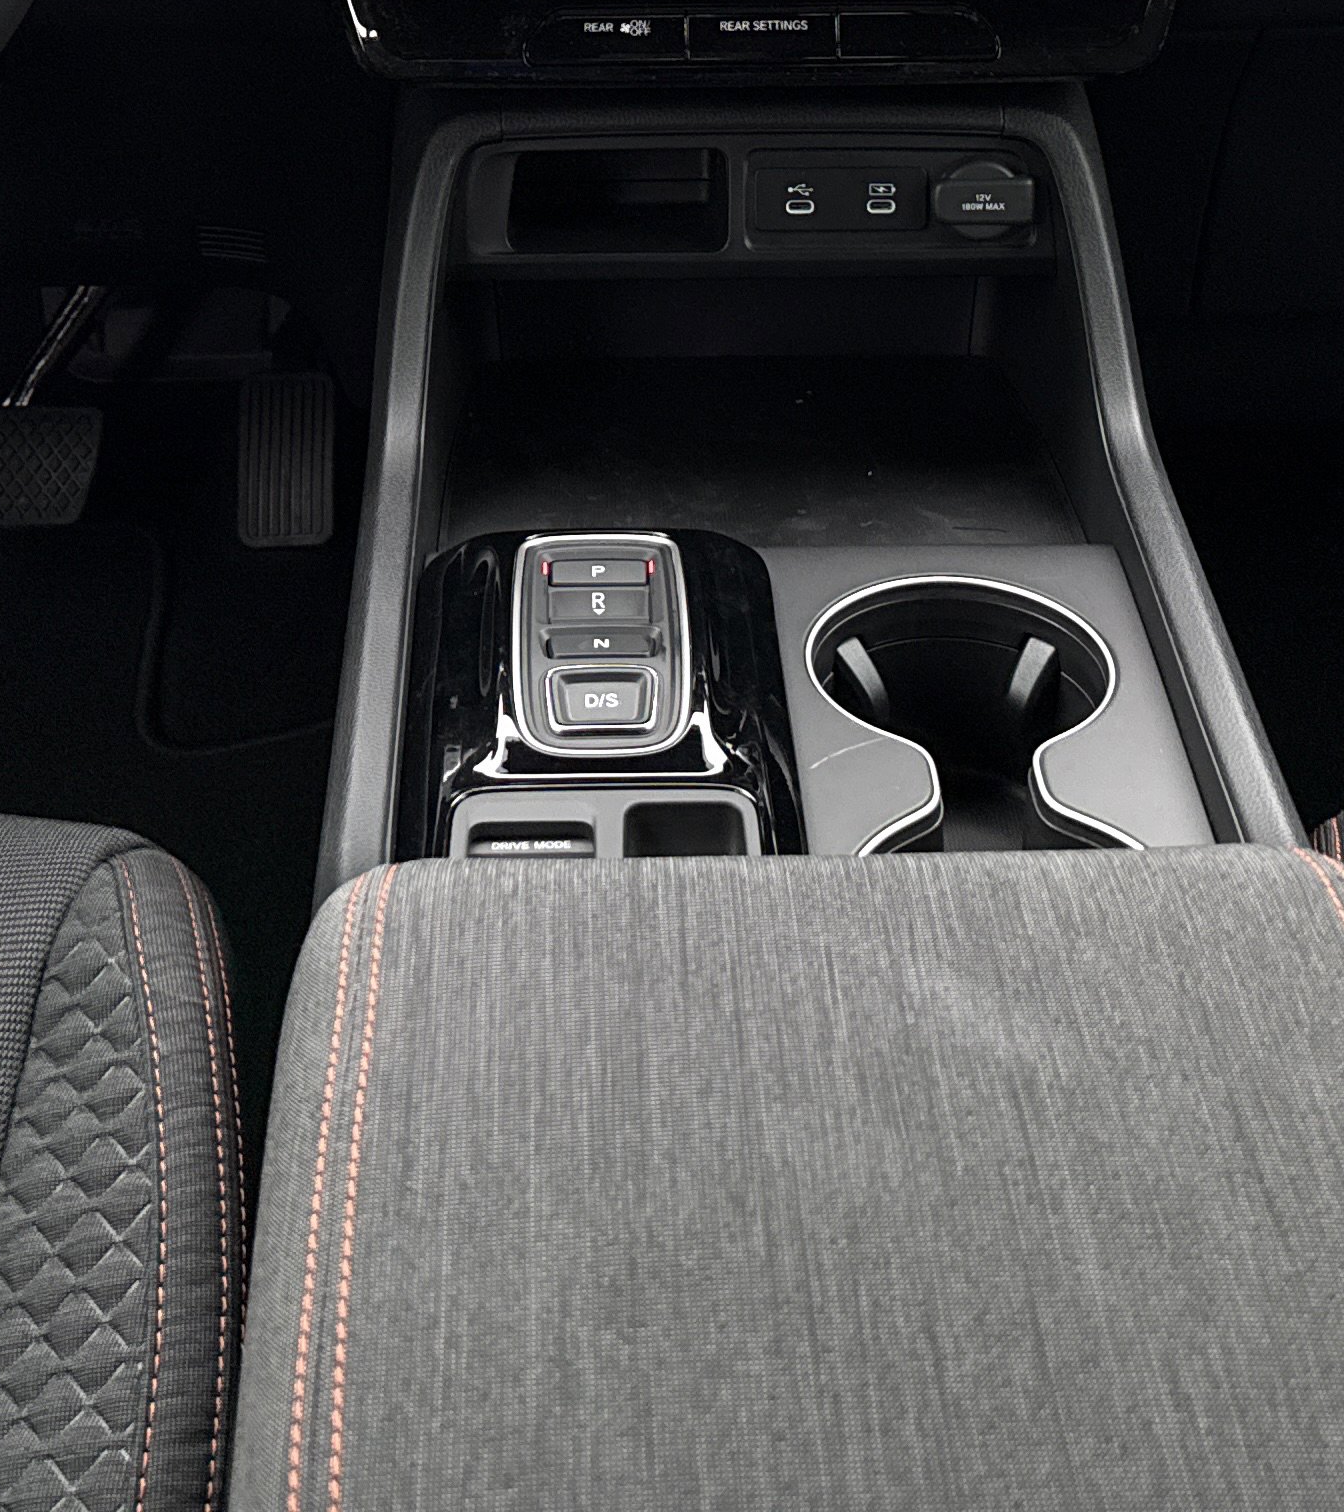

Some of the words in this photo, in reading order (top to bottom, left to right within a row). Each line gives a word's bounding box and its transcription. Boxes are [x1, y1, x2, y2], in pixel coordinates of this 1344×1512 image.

[584, 22, 614, 33] REAR
[719, 20, 750, 31] REAR
[752, 20, 809, 31] SETTINGS
[975, 193, 991, 202] 12V
[961, 202, 984, 211] 180W
[985, 202, 1005, 211] MAX
[591, 565, 606, 577] P
[591, 592, 606, 609] R
[584, 693, 619, 708] D/S
[491, 840, 529, 850] DRIVE
[533, 840, 571, 849] MODE
